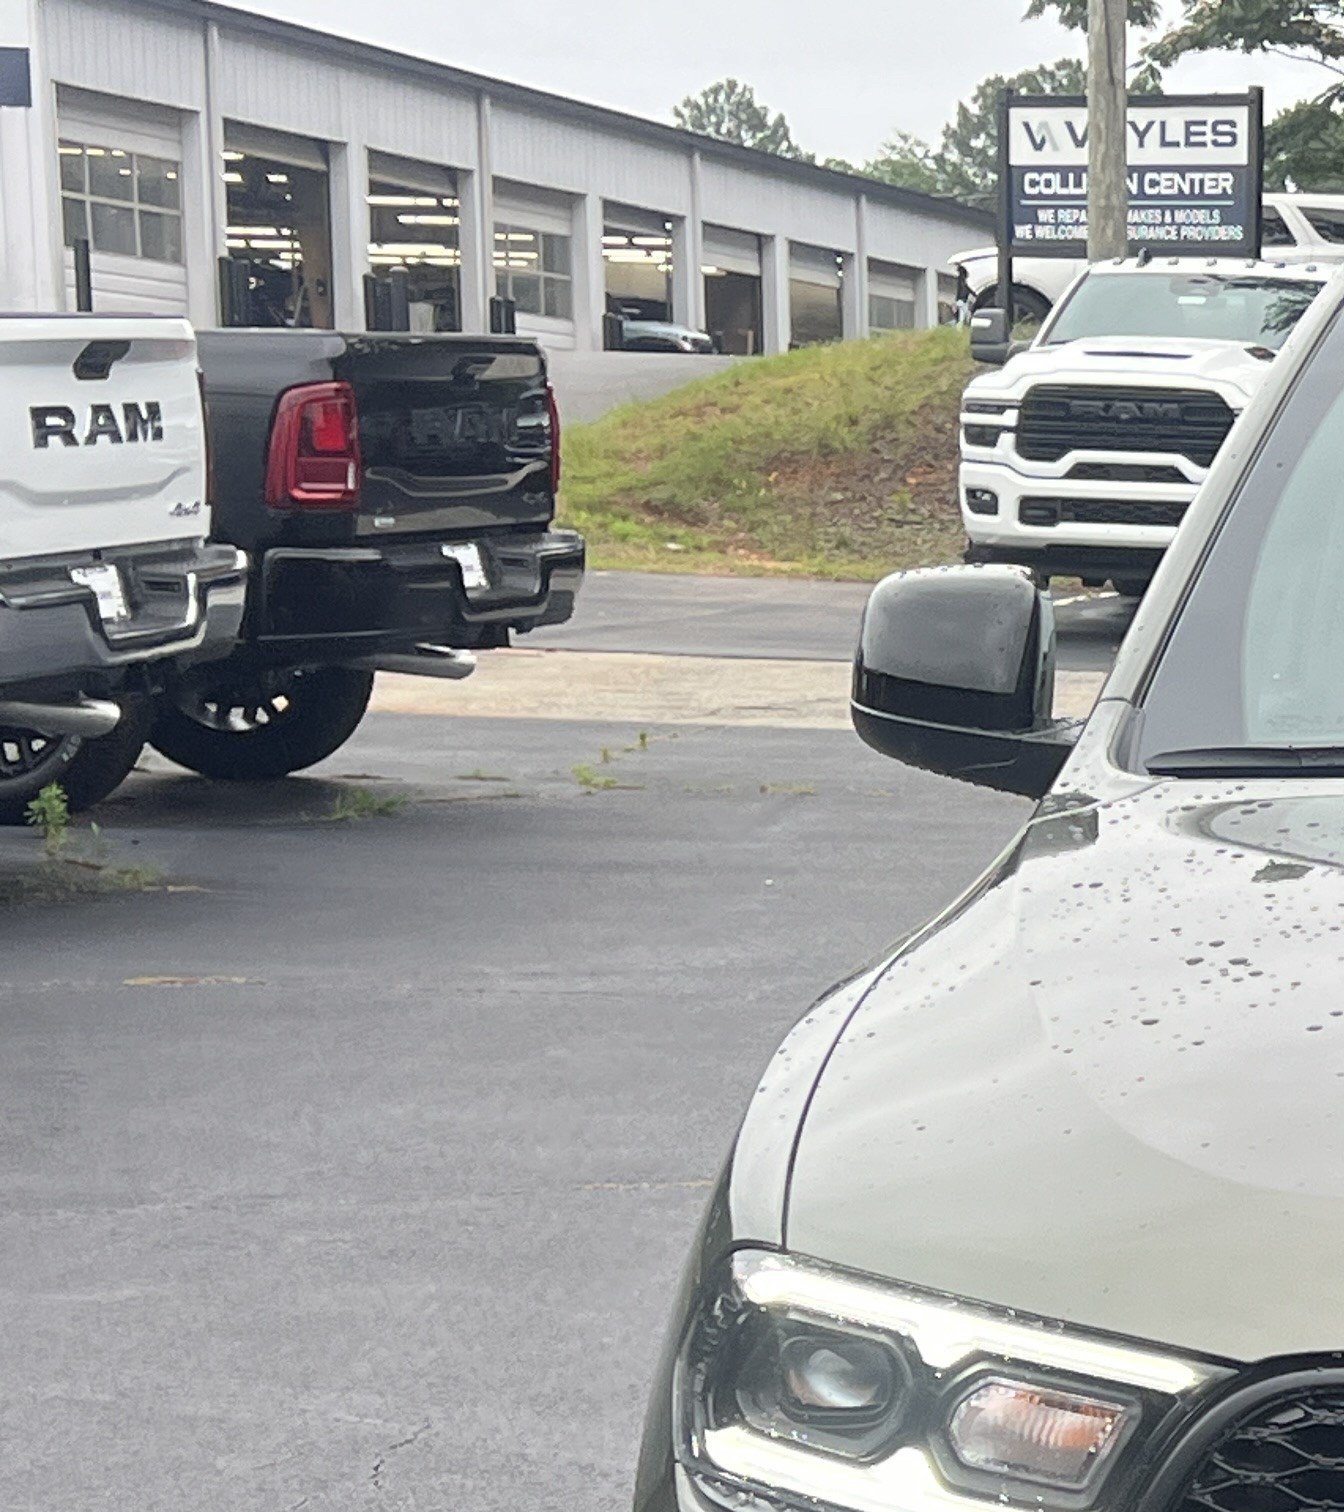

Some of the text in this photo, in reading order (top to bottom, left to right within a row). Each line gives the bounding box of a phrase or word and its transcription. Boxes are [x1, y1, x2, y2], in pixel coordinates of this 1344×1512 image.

[1064, 119, 1238, 149] VYLES
[1023, 172, 1234, 195] COLLIN CENTER
[1037, 209, 1055, 223] WE
[1174, 209, 1221, 224] MODELS
[1014, 224, 1033, 239] WE
[1180, 225, 1244, 240] PROVIDERS
[29, 401, 164, 449] RAM
